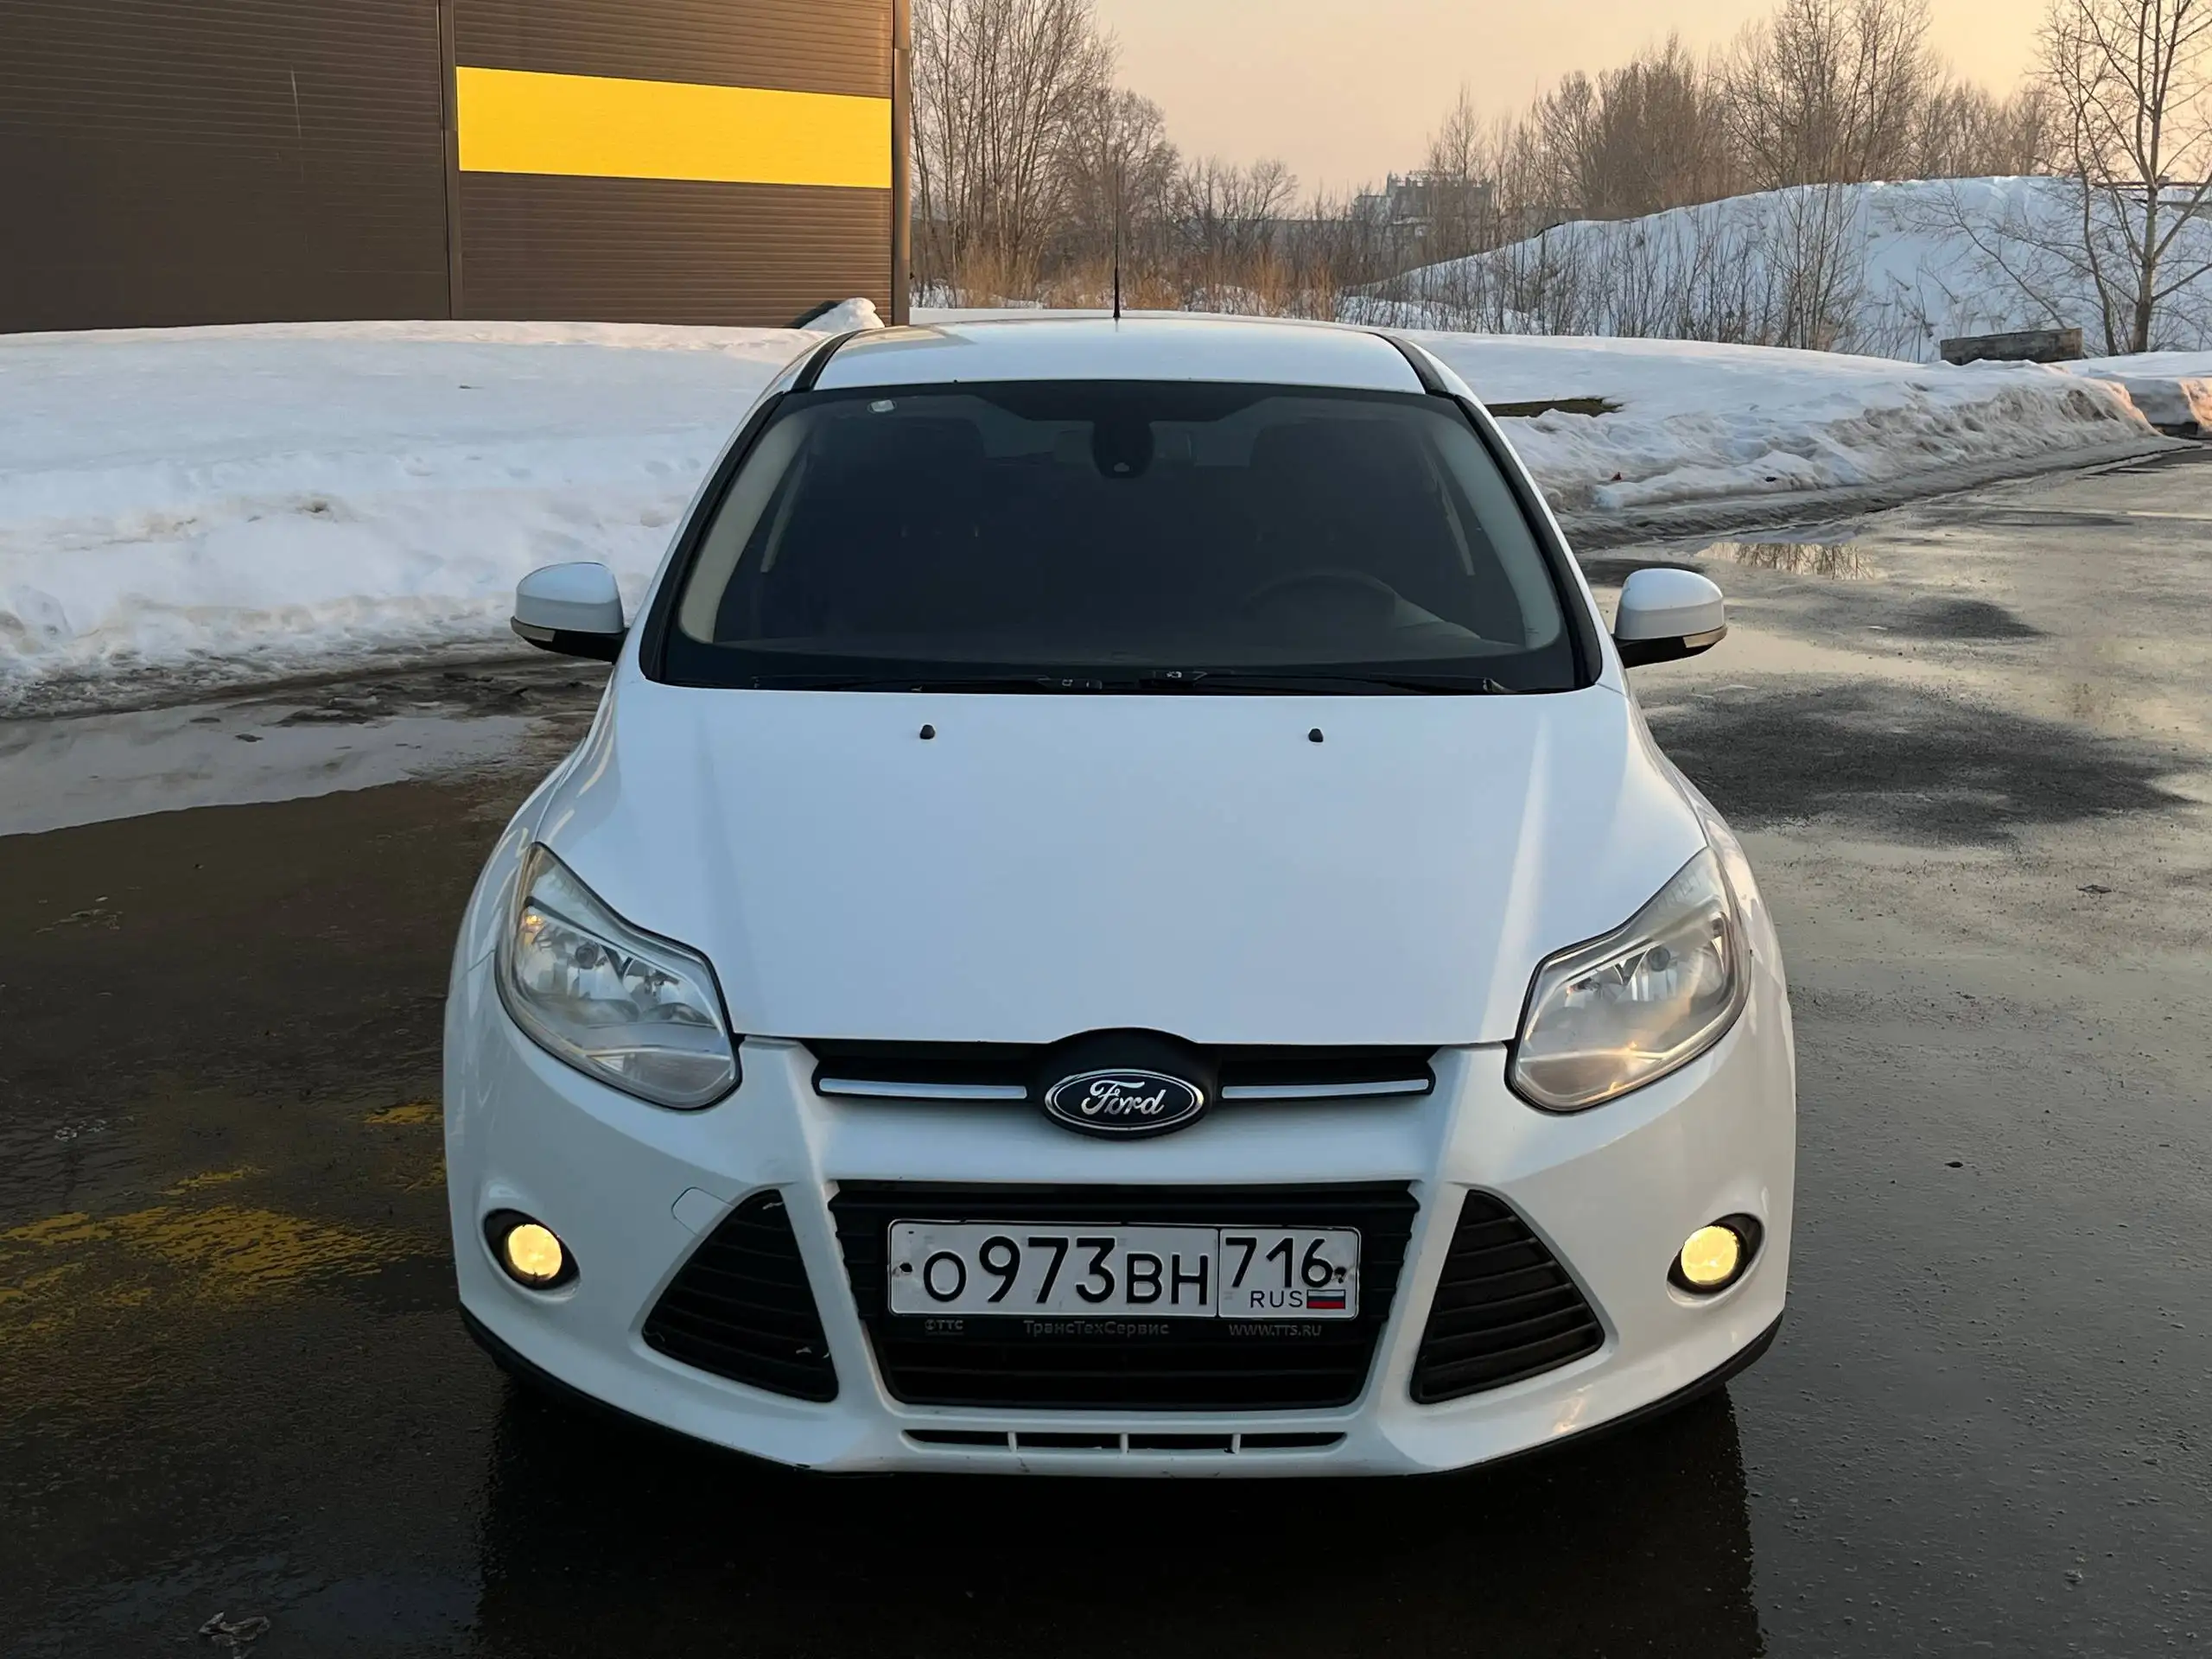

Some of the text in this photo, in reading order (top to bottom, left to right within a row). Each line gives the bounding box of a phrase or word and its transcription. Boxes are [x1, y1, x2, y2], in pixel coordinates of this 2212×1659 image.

[1081, 1079, 1166, 1115] Ford
[1224, 1237, 1333, 1287] 716
[1249, 1290, 1304, 1308] RUS
[1023, 1319, 1170, 1338] ТрансТехСервис
[1228, 1323, 1323, 1337] WWW.TTS.RU
